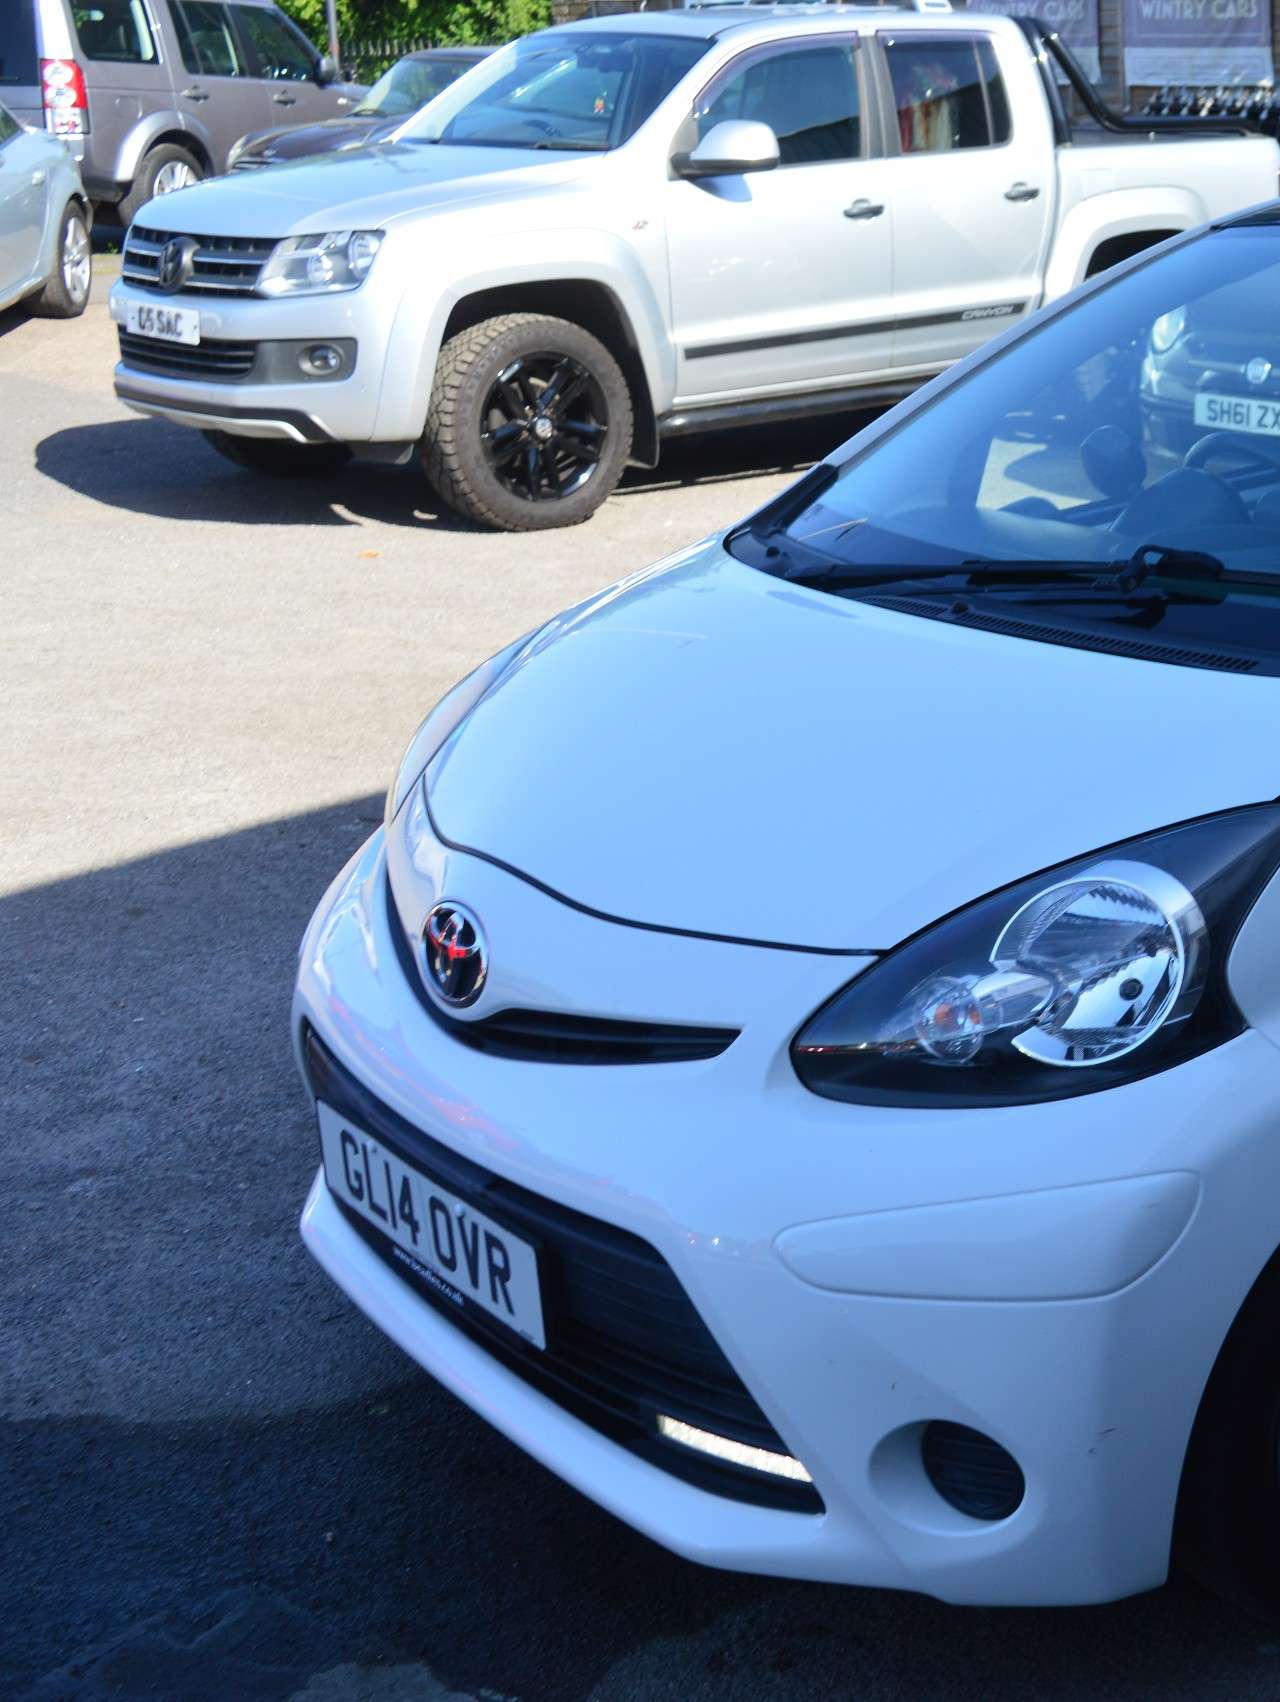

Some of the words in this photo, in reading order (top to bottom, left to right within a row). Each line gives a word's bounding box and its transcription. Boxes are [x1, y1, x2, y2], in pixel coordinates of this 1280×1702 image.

[1043, 1, 1085, 20] CARS
[1140, 0, 1206, 19] WINTRY
[1212, 0, 1258, 18] CARS
[961, 305, 1014, 320] CANYON
[1206, 399, 1250, 426] SH61
[340, 1129, 420, 1246] GL14
[429, 1195, 515, 1316] OVR
